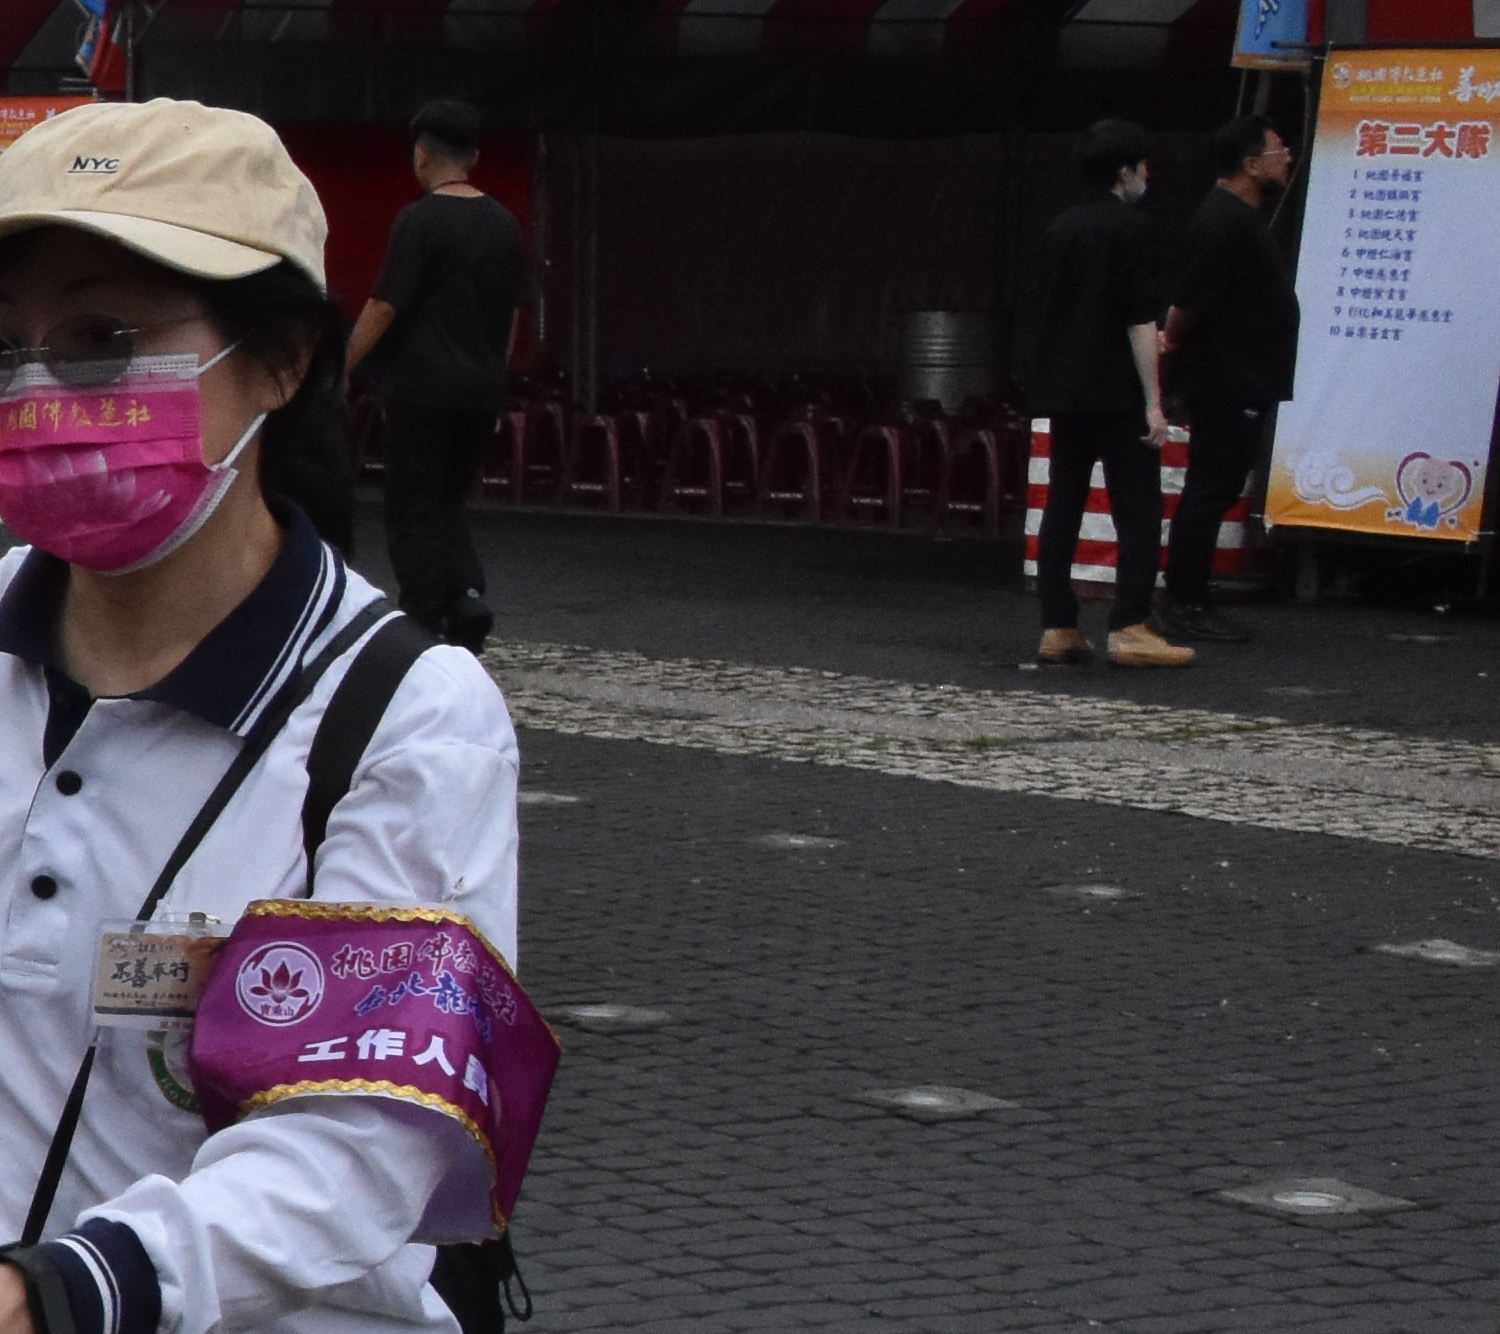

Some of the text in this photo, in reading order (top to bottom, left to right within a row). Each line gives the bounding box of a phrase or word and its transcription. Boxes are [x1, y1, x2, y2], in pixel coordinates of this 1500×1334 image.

[1355, 119, 1492, 159] 第二大隊
[71, 156, 120, 171] NYC
